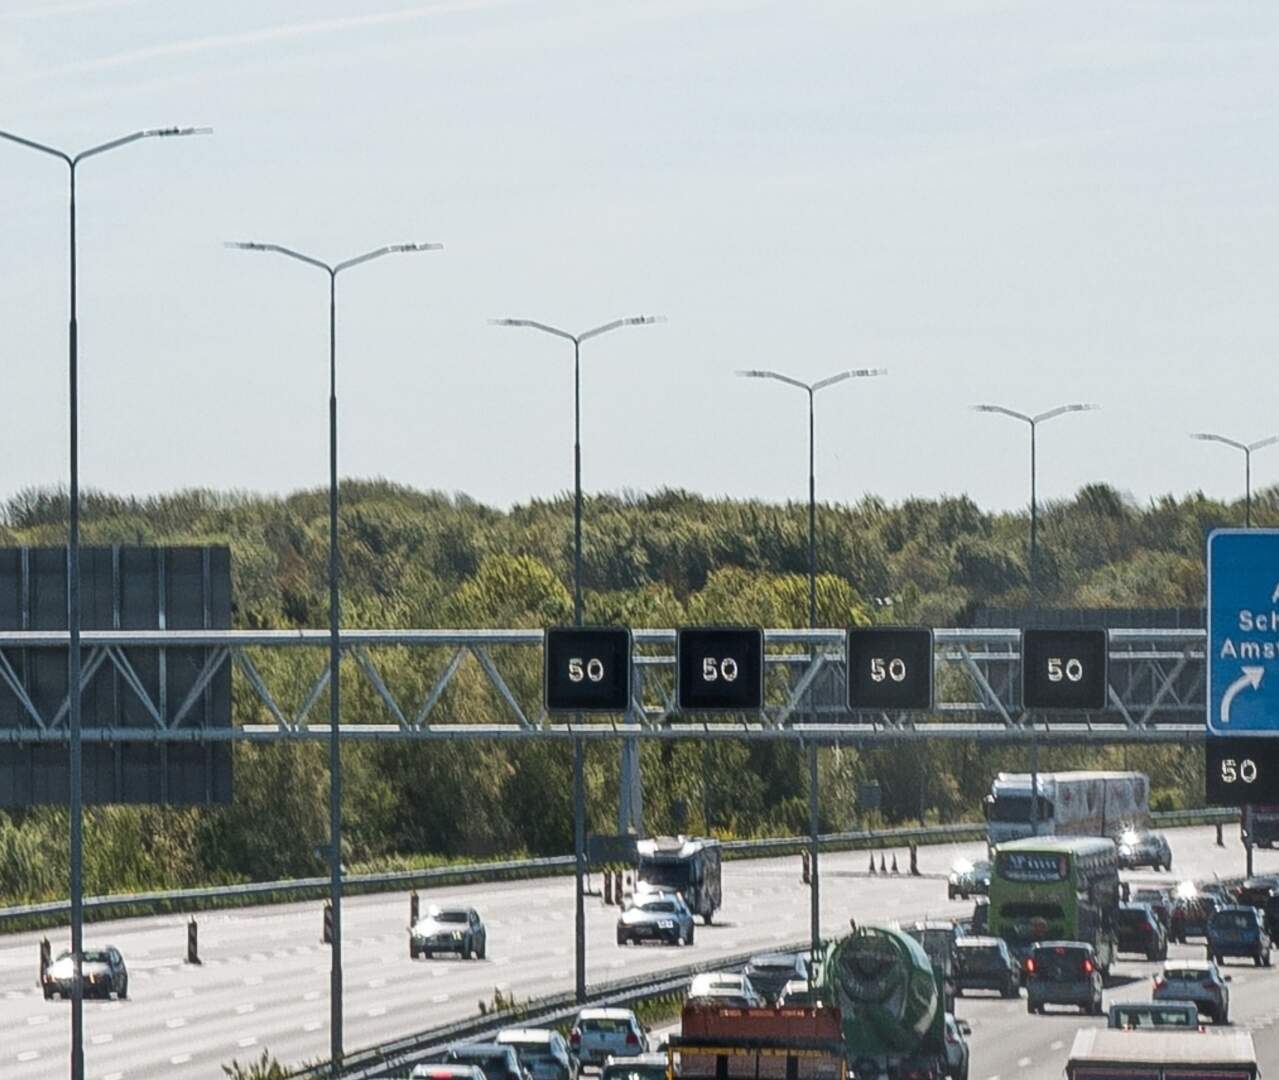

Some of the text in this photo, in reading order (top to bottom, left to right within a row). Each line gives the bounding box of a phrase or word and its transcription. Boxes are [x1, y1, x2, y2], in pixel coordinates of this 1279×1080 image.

[568, 658, 604, 682] 50
[702, 657, 738, 682] 50
[870, 657, 907, 682] 50
[1047, 657, 1083, 682] 50
[1221, 758, 1257, 784] 50
